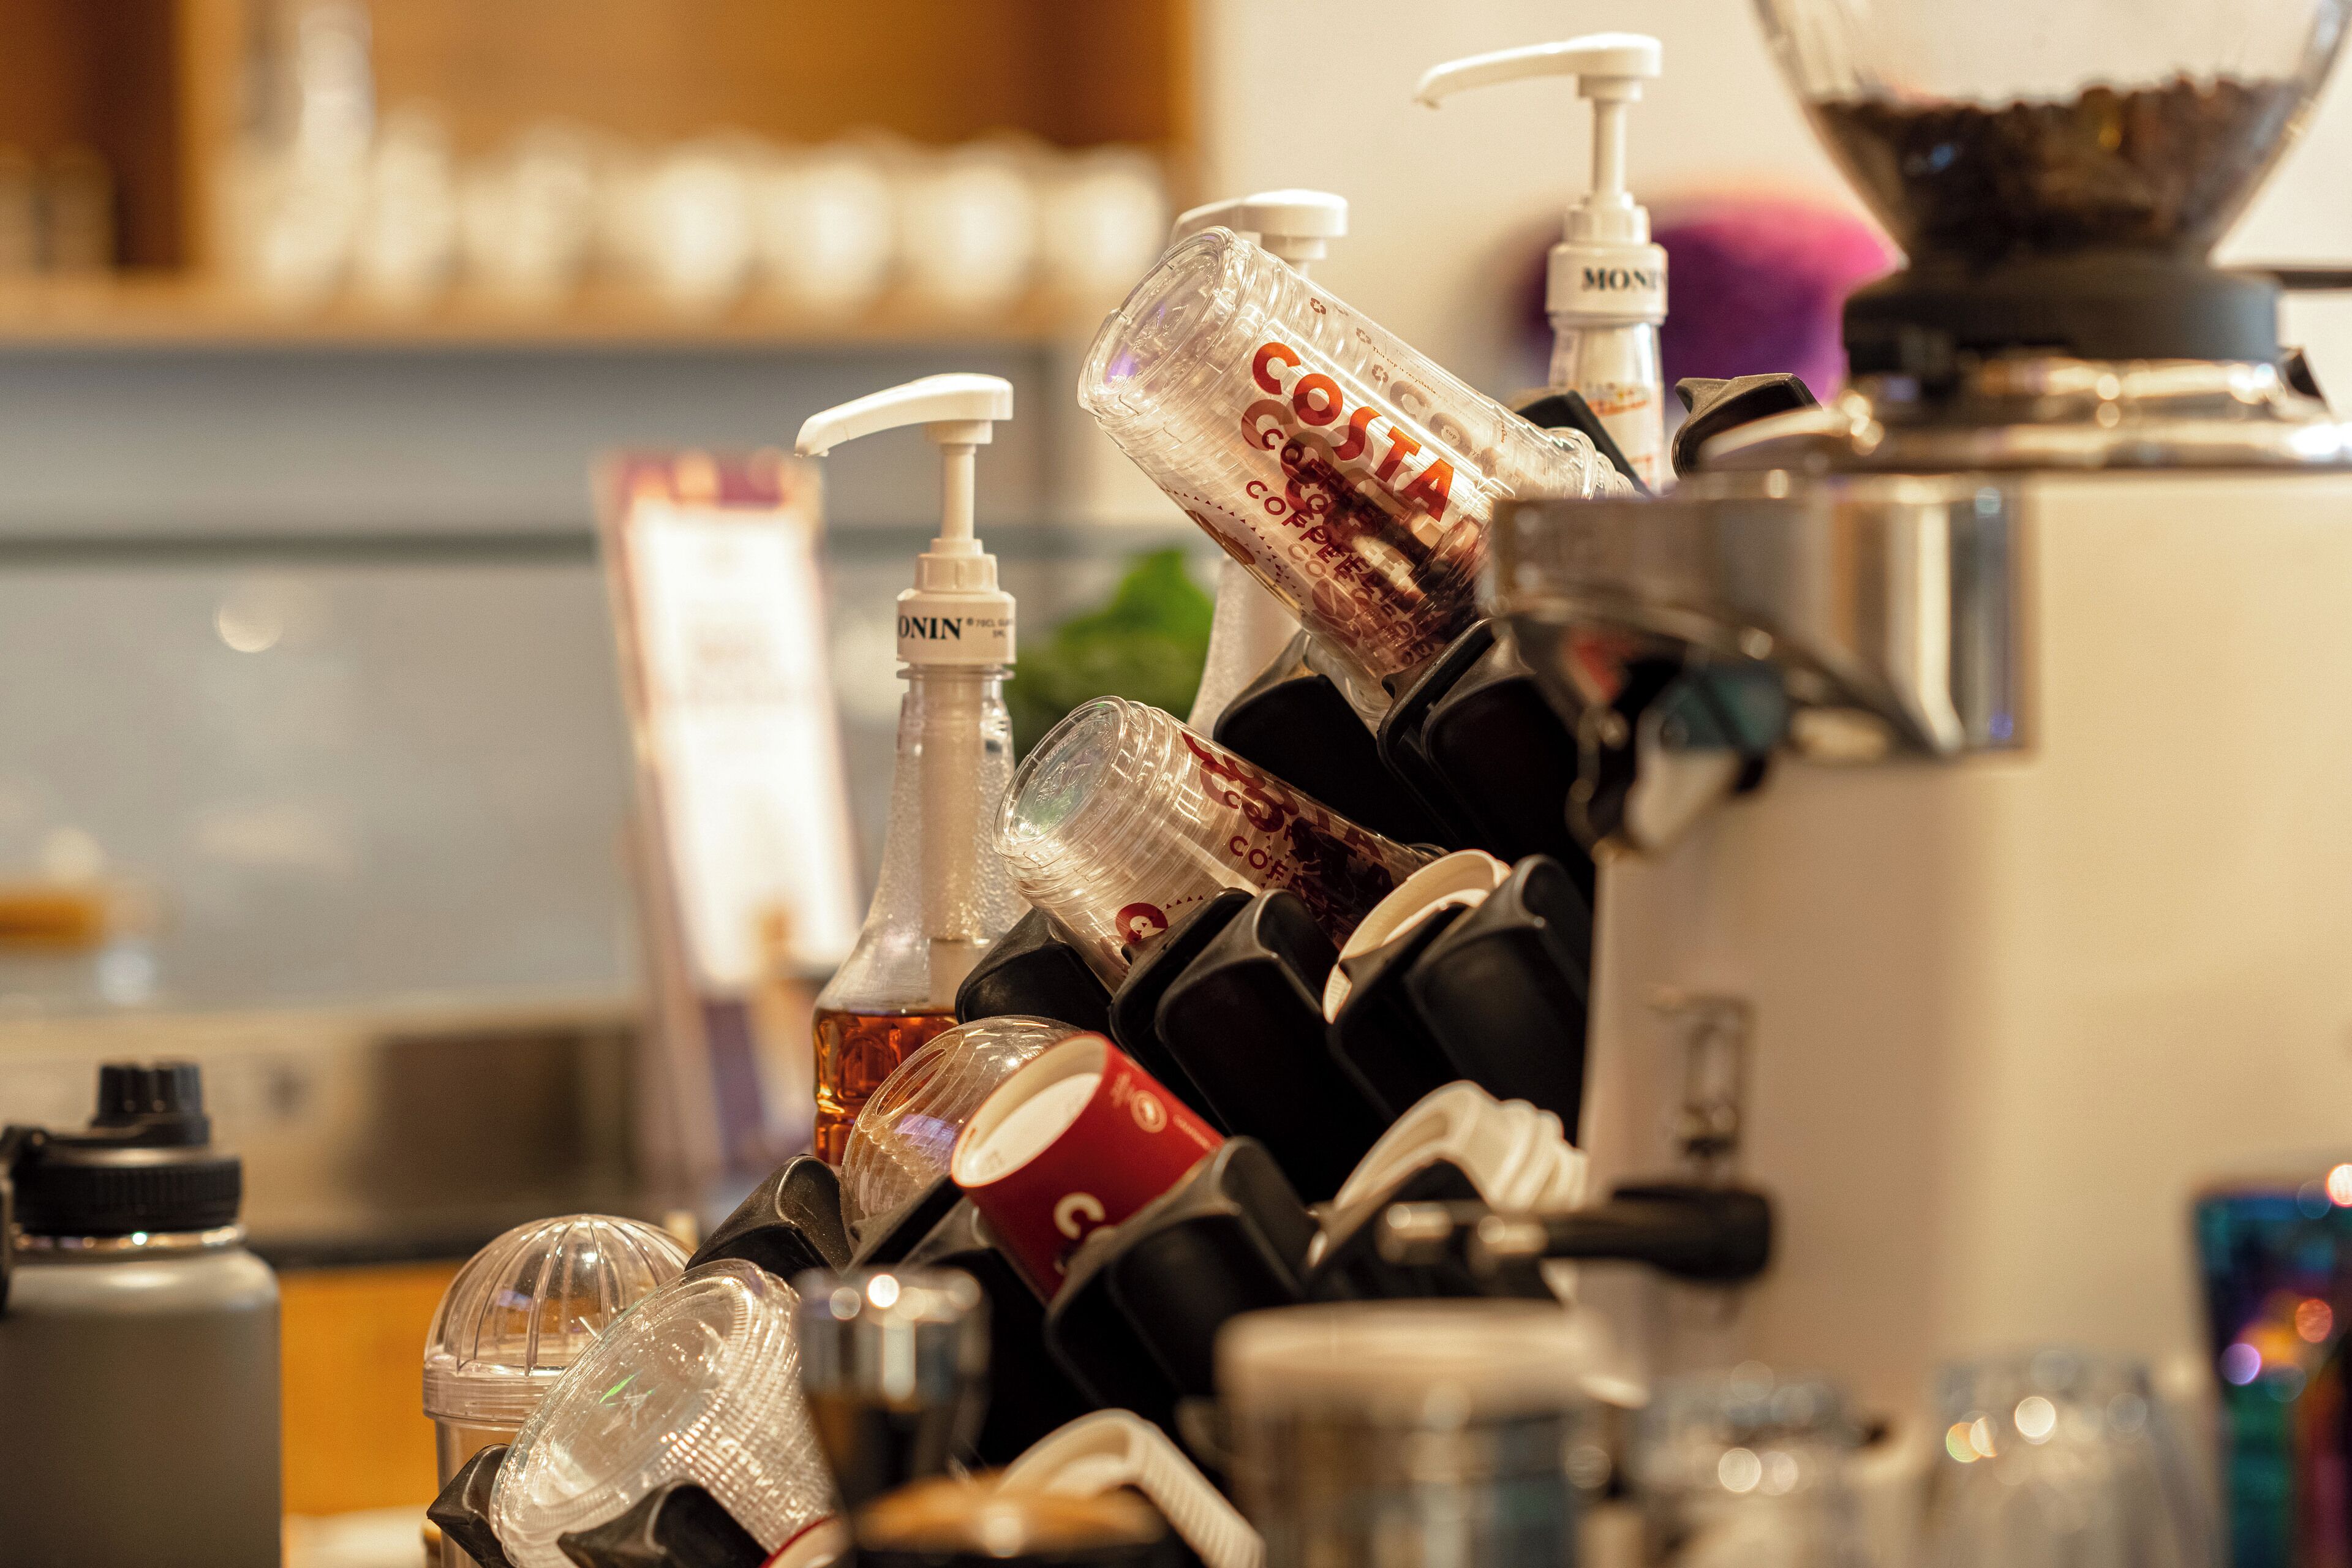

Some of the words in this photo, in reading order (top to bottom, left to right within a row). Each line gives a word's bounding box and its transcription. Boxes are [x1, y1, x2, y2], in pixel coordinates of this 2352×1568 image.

[1372, 345, 1385, 358] This
[1387, 358, 1398, 368] cup
[1406, 371, 1436, 394] recyclable
[1253, 341, 1454, 522] COSTA
